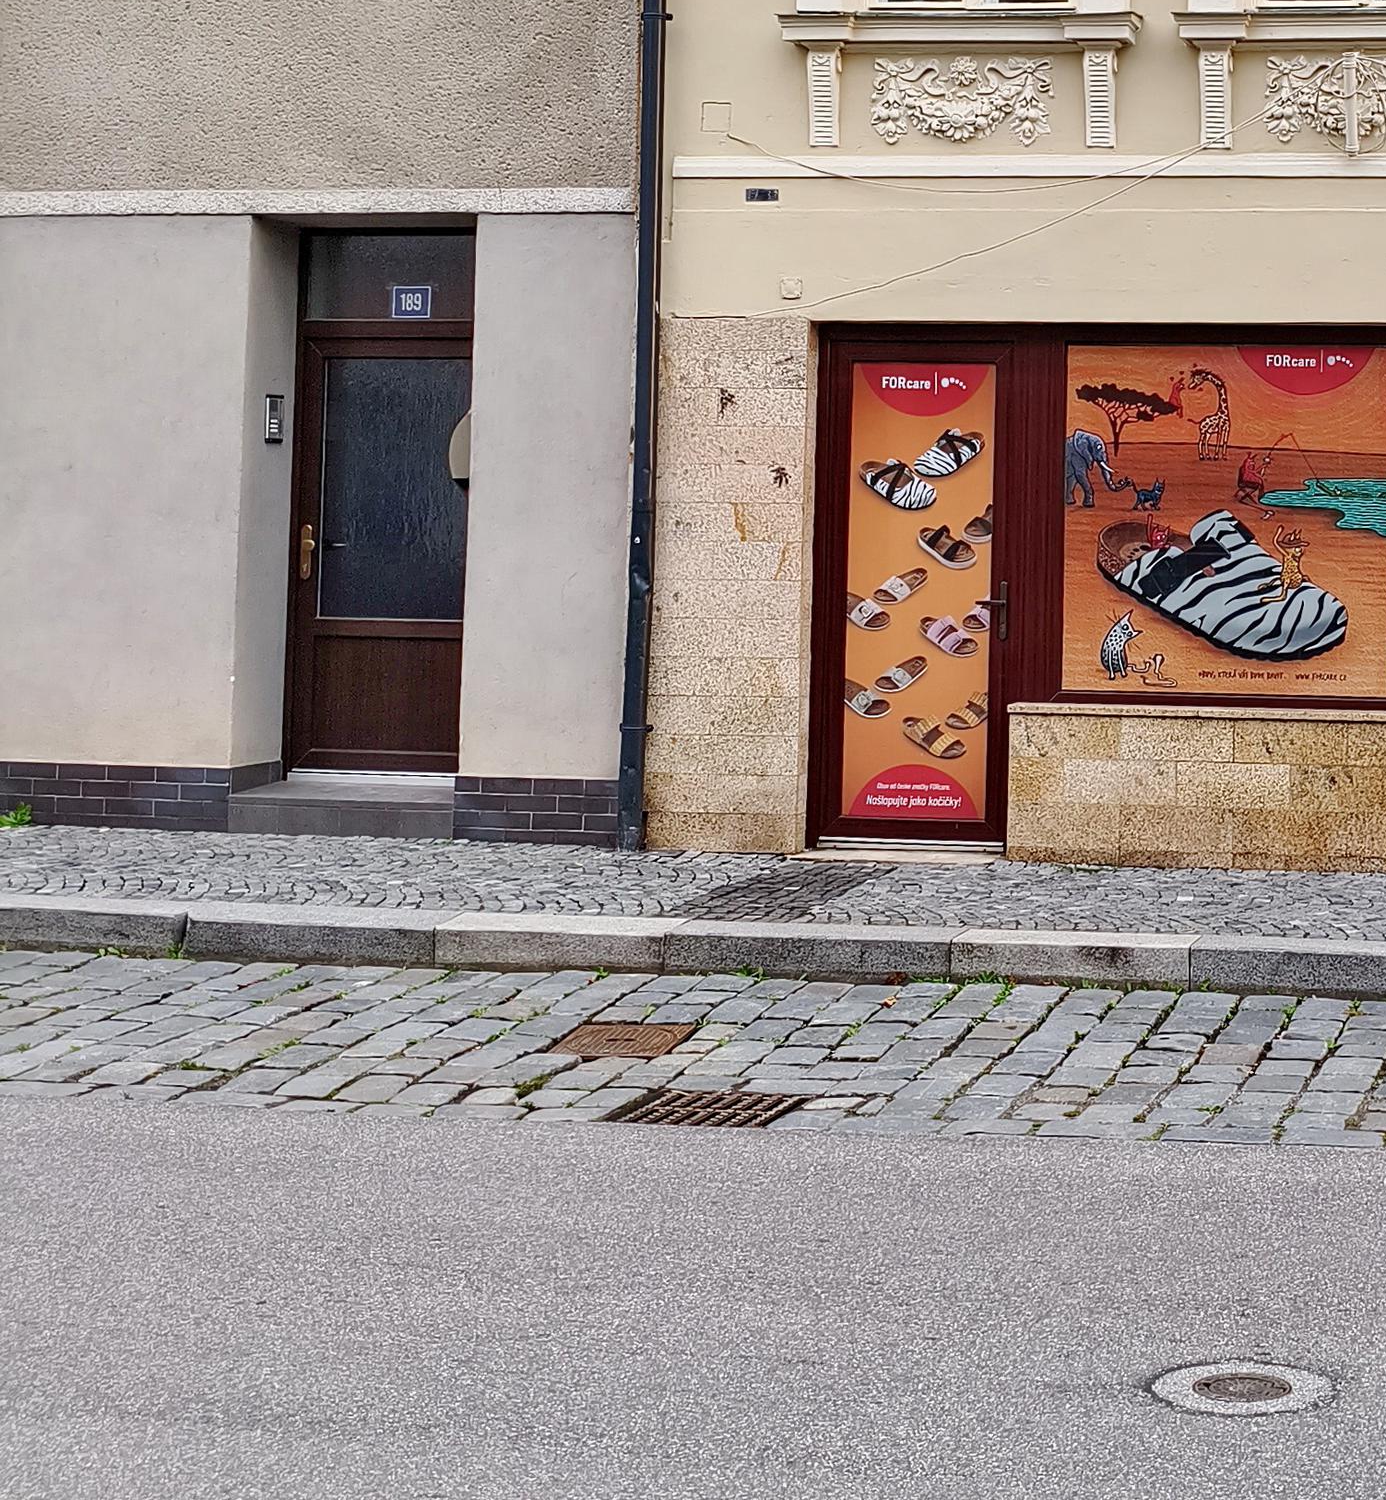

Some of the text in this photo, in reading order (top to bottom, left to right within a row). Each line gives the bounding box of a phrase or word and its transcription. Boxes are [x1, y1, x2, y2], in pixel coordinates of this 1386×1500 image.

[400, 293, 422, 311] 189
[1266, 354, 1316, 367] FORcare
[882, 376, 931, 389] FORcare
[866, 794, 962, 809] Našlapujte jako kočičky!
